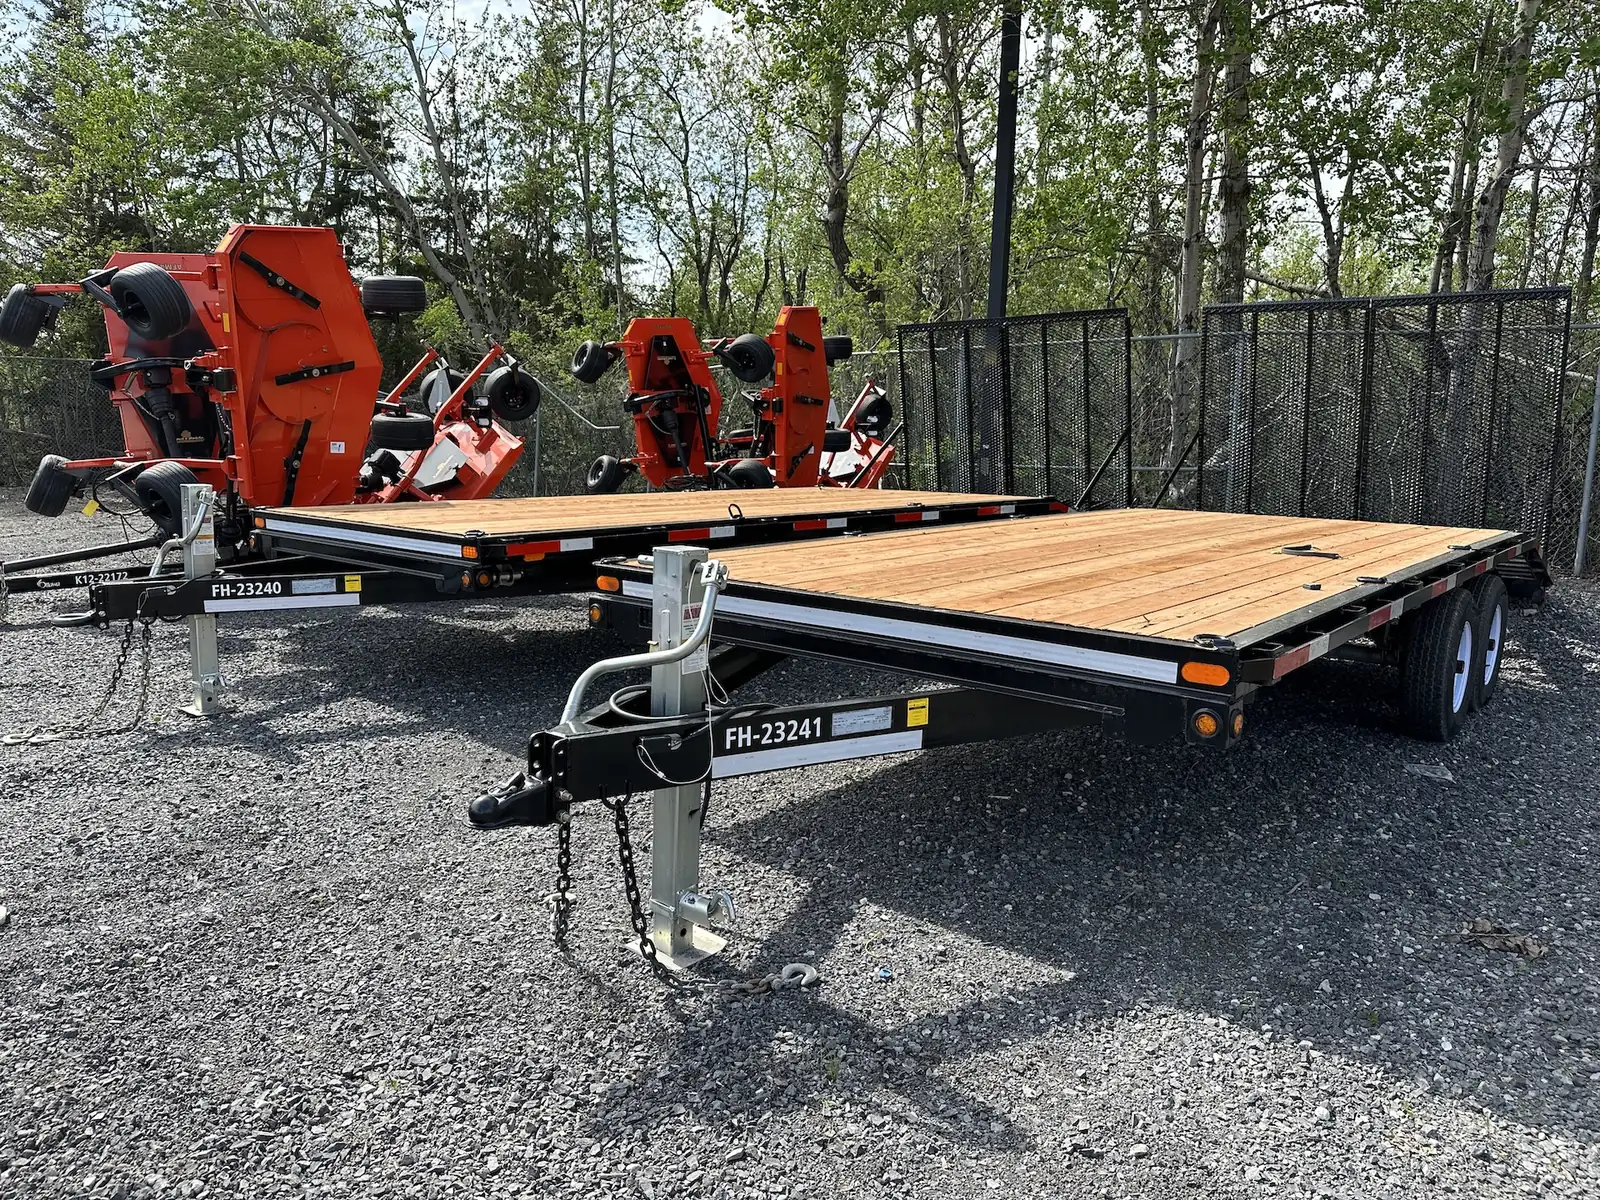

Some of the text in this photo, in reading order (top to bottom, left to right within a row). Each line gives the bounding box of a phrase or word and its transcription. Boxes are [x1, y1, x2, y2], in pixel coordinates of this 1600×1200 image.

[74, 571, 128, 585] K12-22172
[211, 581, 282, 597] FH-23240
[725, 716, 822, 750] FH-23241
